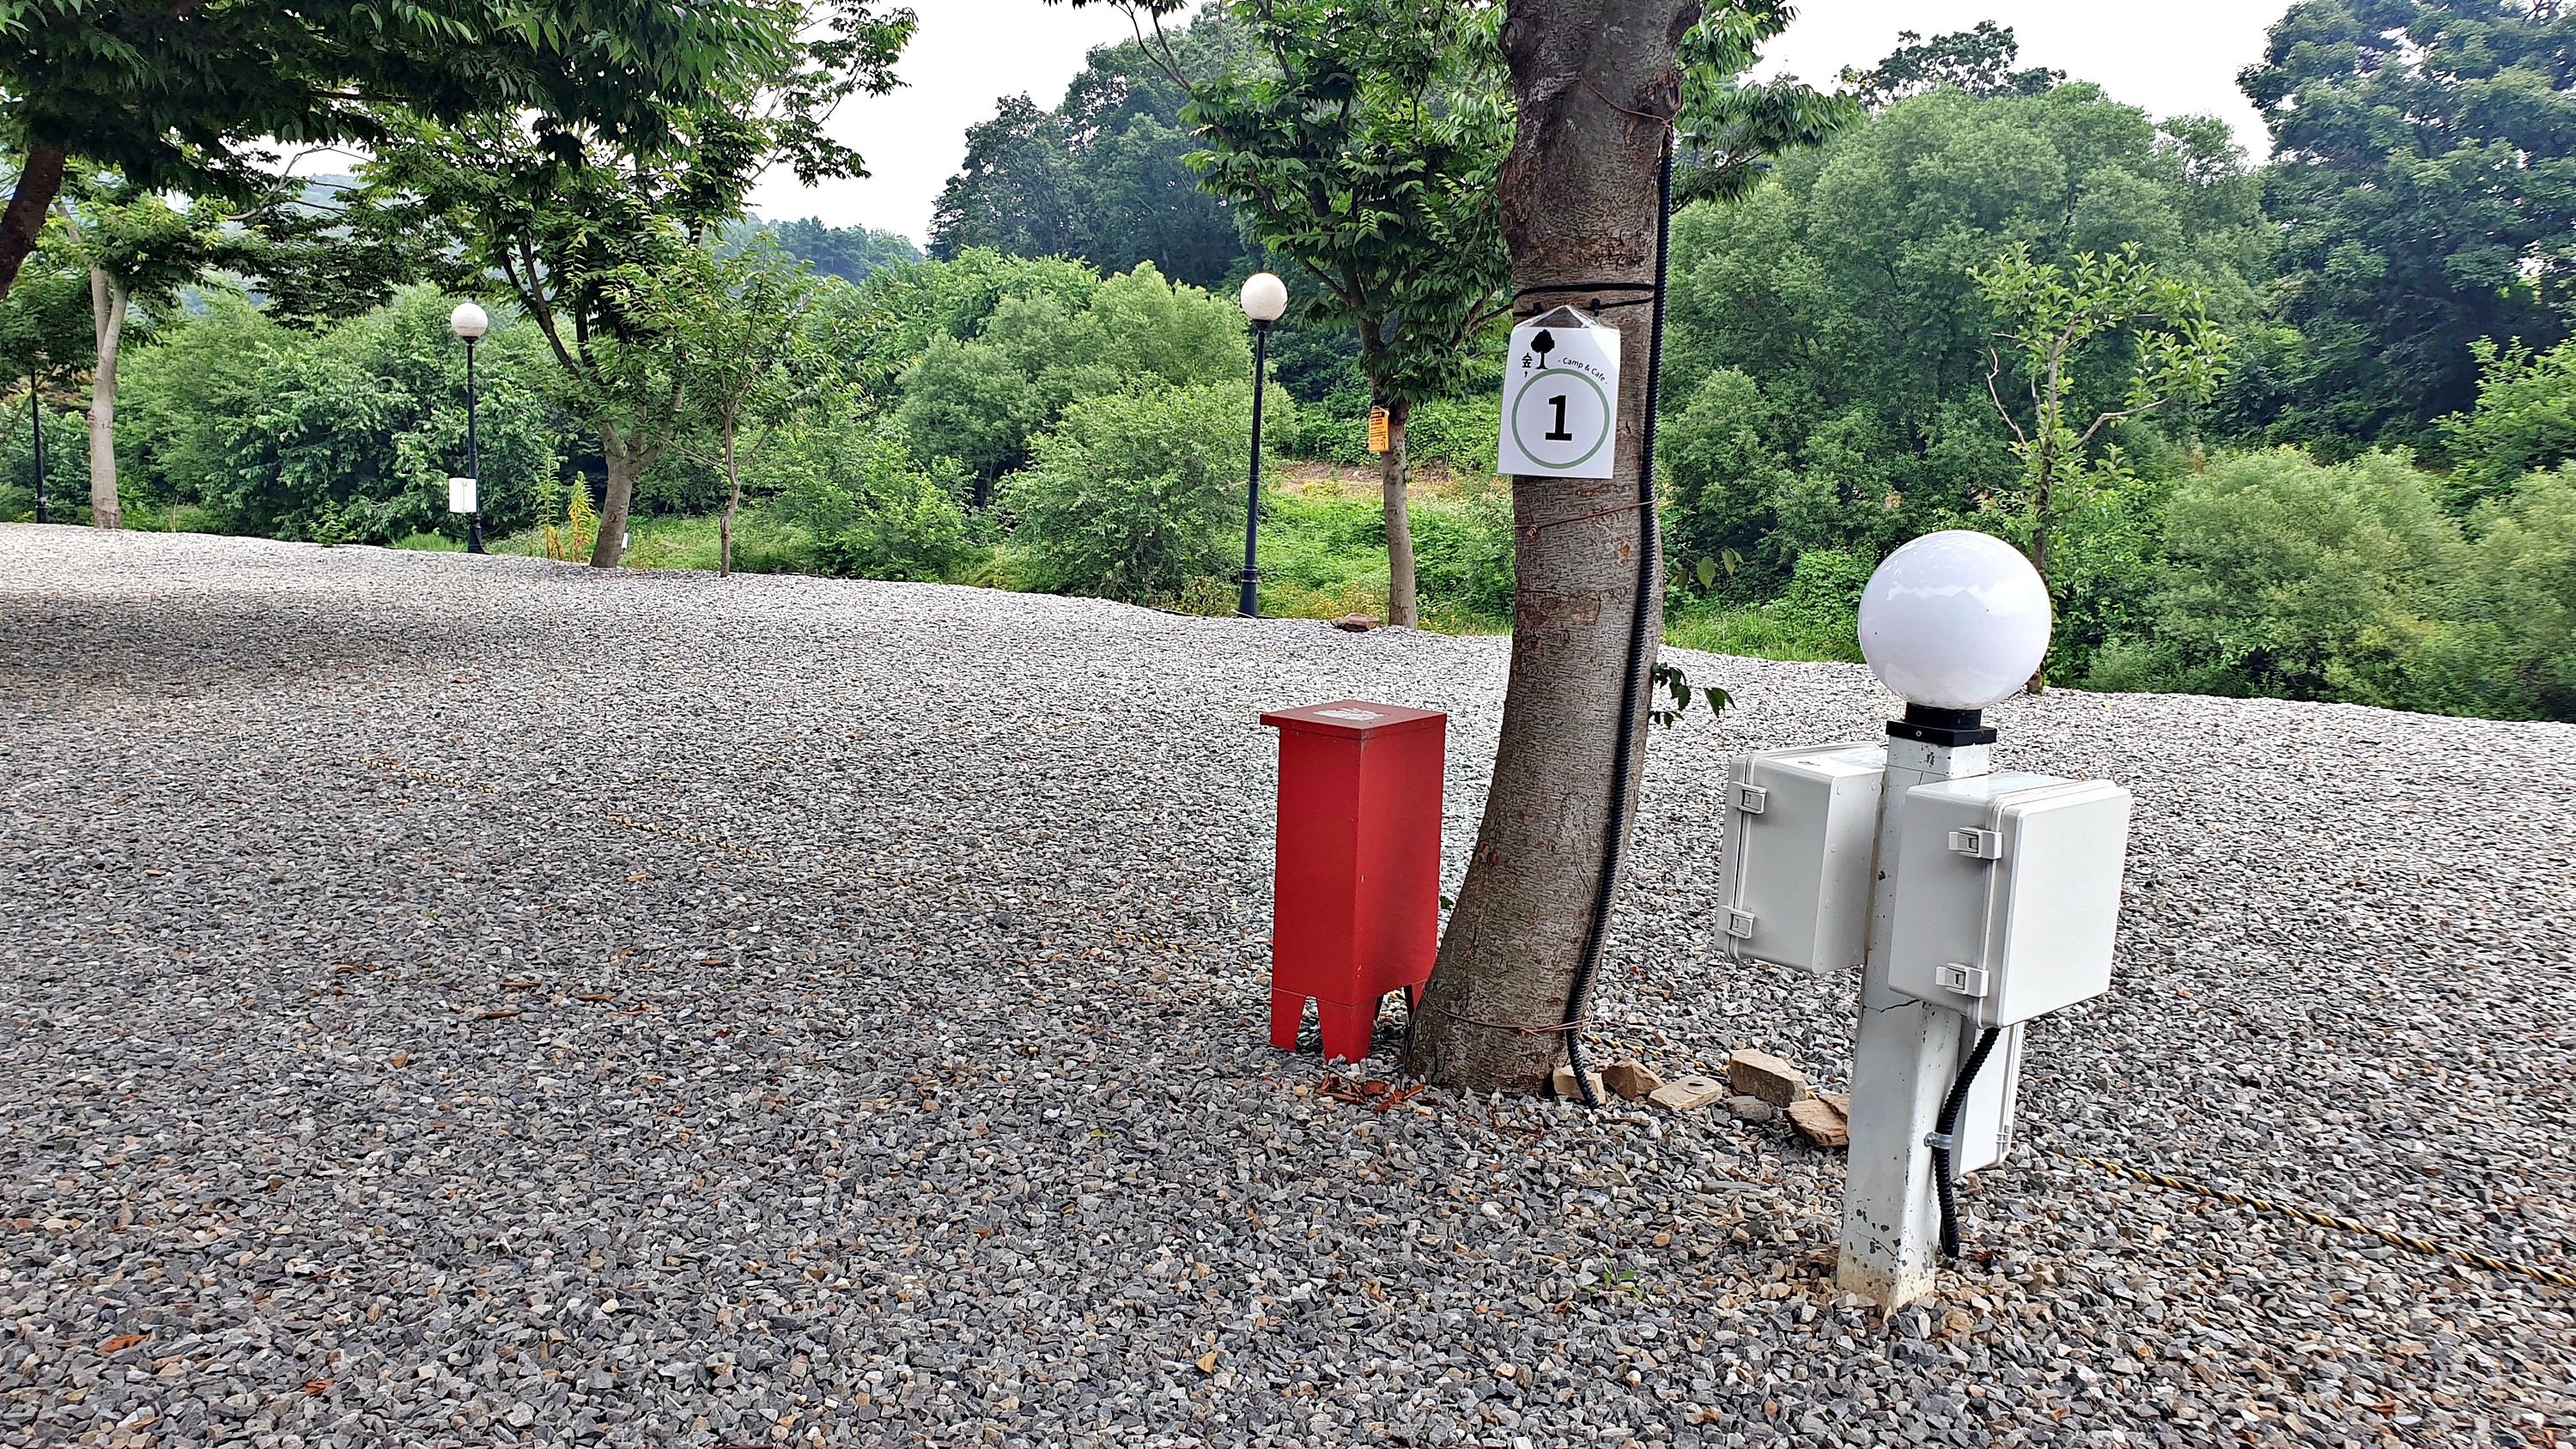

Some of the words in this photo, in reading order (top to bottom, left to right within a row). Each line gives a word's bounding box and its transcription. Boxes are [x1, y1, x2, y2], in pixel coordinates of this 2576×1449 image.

[1563, 357, 1583, 368] Camp
[1591, 368, 1606, 382] Cafe
[1545, 395, 1572, 441] 1
